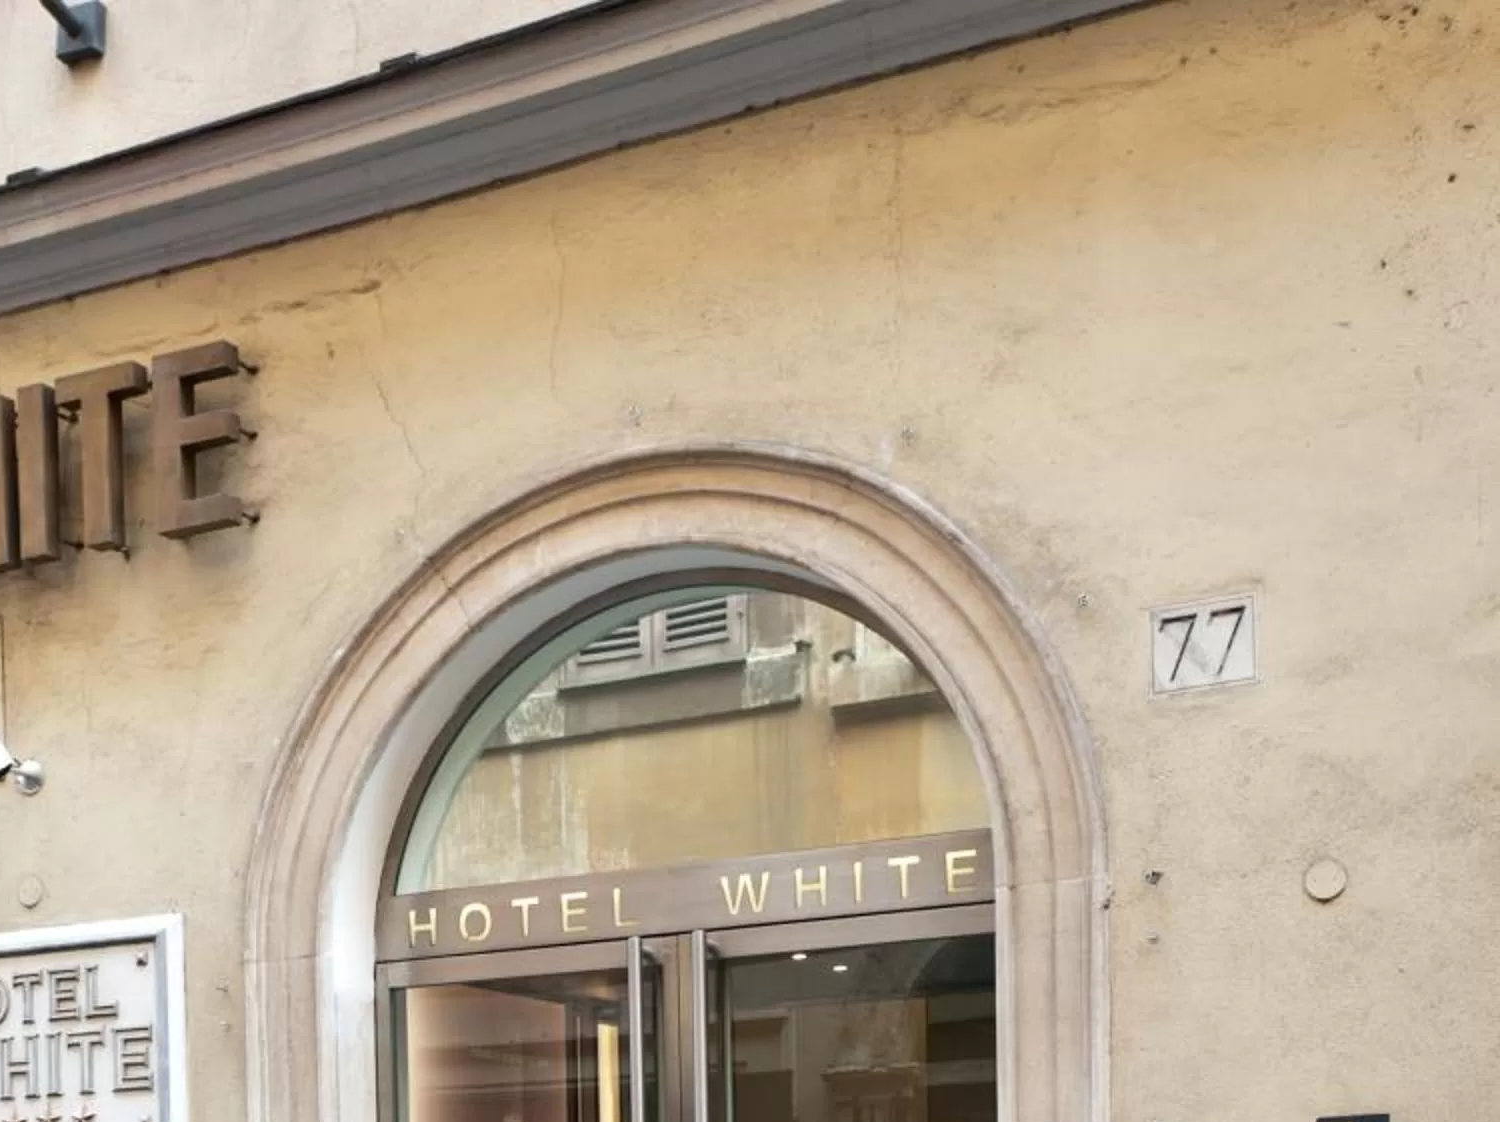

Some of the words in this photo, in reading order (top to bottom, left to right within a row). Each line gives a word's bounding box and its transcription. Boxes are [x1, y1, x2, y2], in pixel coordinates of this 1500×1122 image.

[1159, 605, 1246, 682] 77
[408, 886, 642, 948] HOTEL
[720, 848, 978, 916] WHITE
